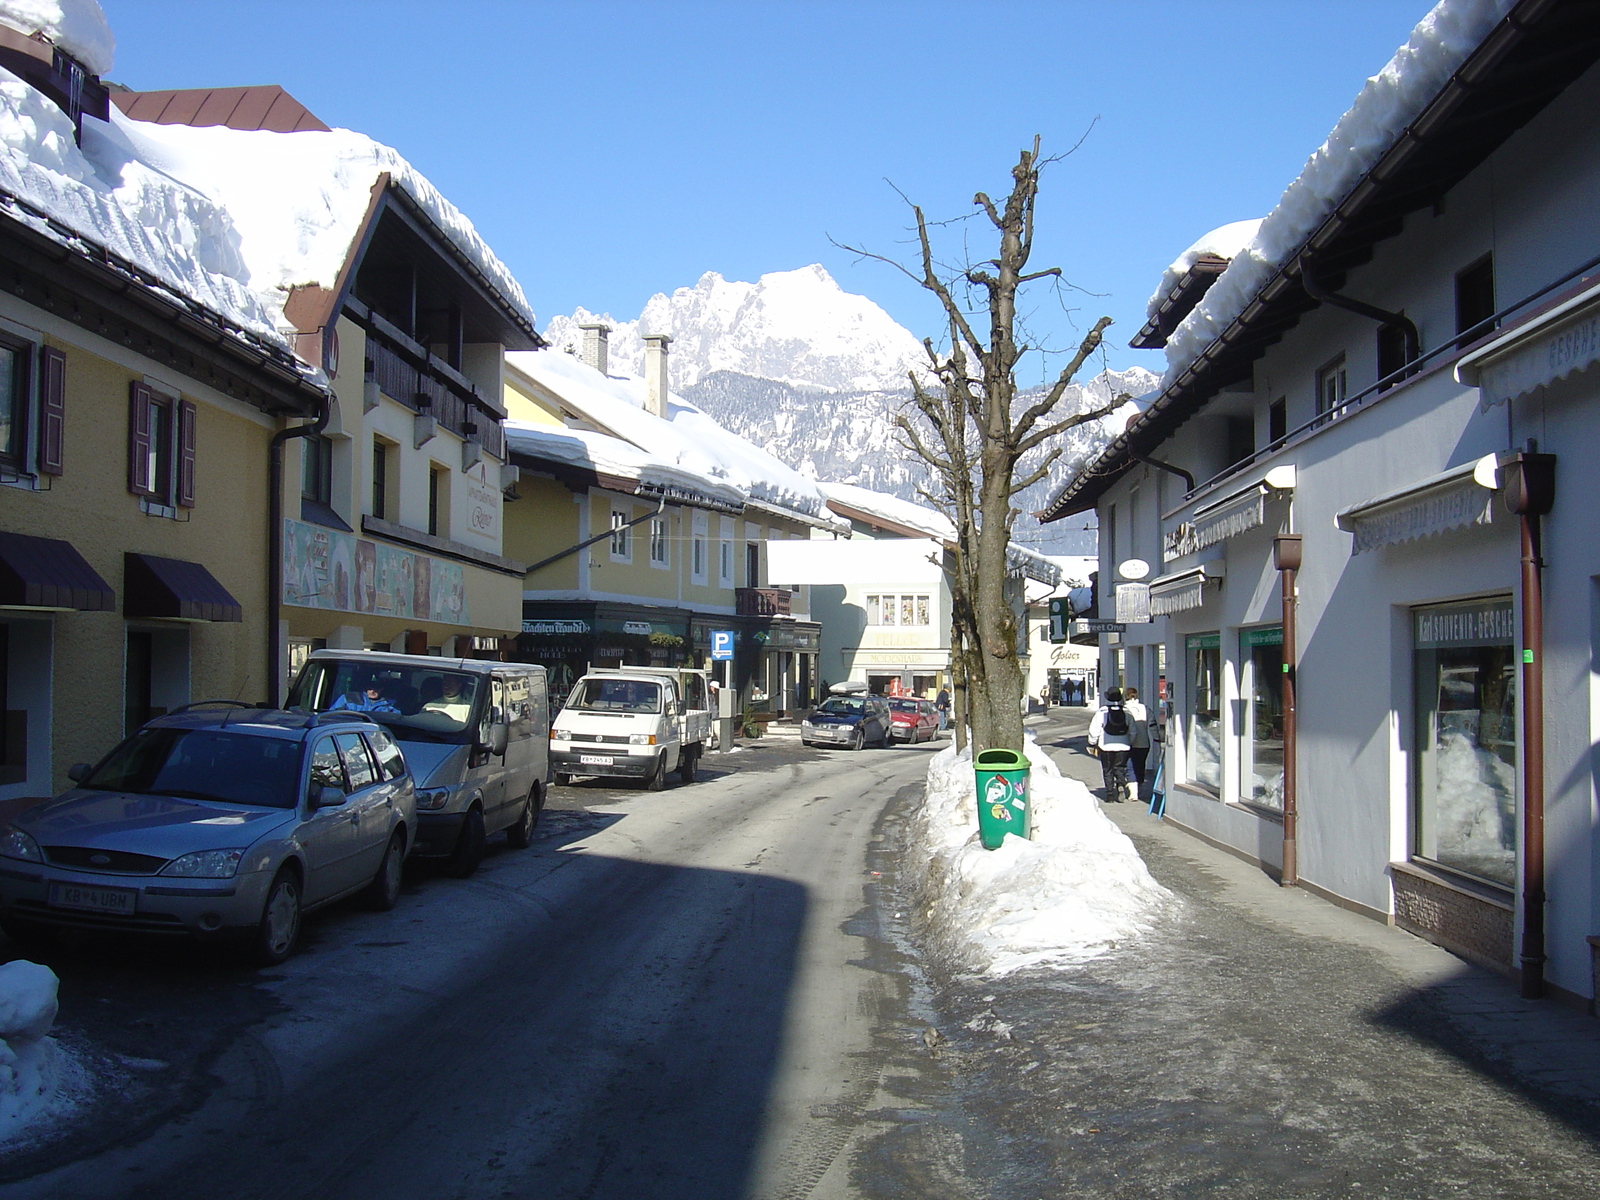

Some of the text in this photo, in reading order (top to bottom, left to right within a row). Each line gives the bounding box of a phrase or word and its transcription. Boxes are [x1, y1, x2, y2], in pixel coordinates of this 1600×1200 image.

[1080, 623, 1124, 632] Street One
[715, 633, 729, 650] P
[875, 633, 921, 646] FELLER
[870, 655, 923, 664] MODENHAUS
[64, 888, 127, 909] KB 4 UBN
